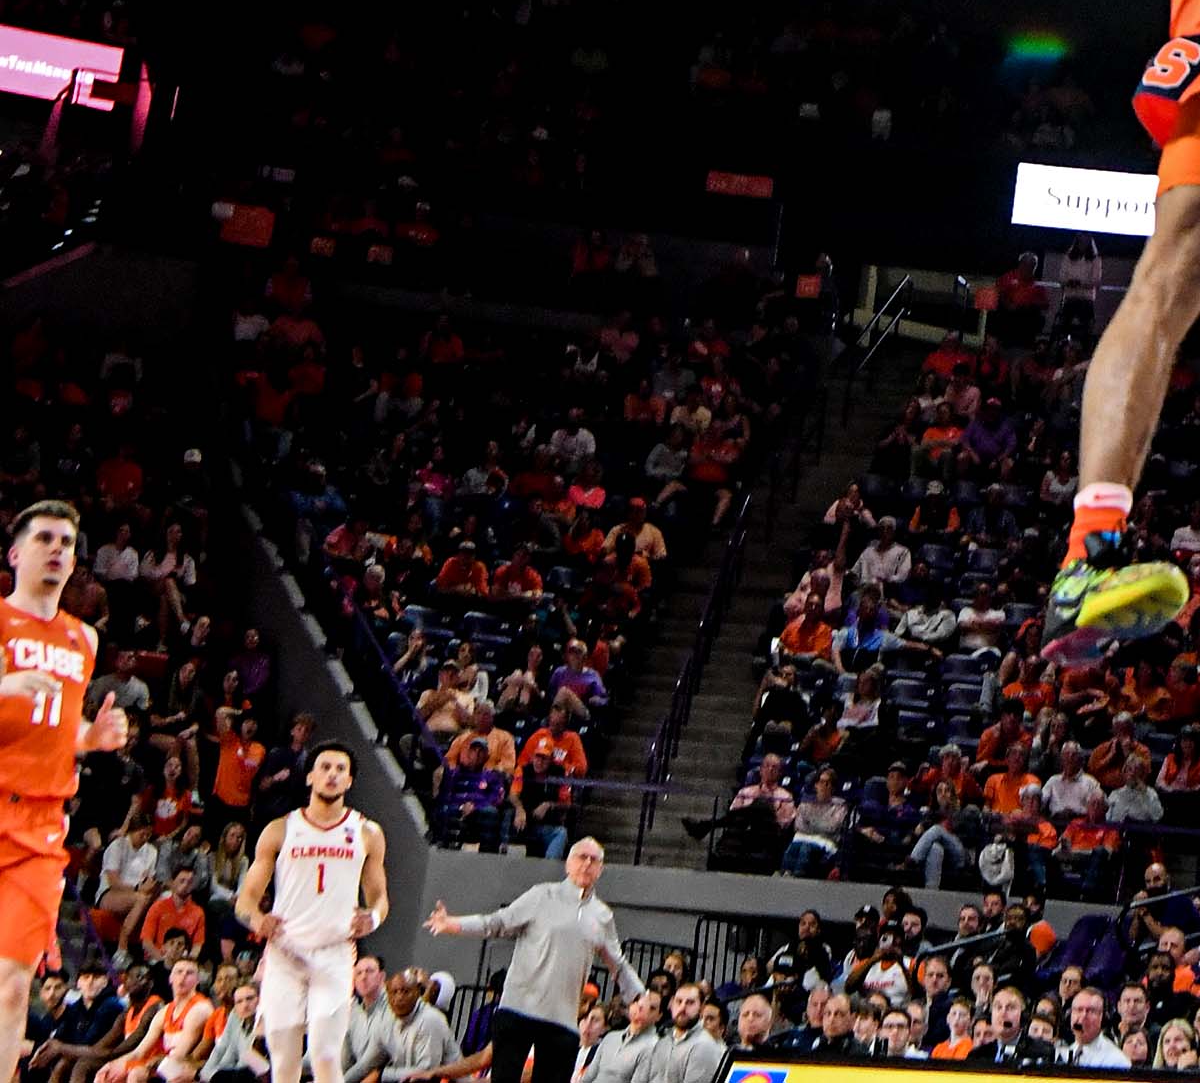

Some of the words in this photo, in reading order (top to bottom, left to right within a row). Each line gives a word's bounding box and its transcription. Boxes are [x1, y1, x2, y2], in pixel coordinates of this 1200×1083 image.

[1047, 187, 1156, 218] Suppor
[32, 682, 63, 727] 11
[291, 846, 354, 859] CLEMSON
[317, 863, 325, 894] 1
